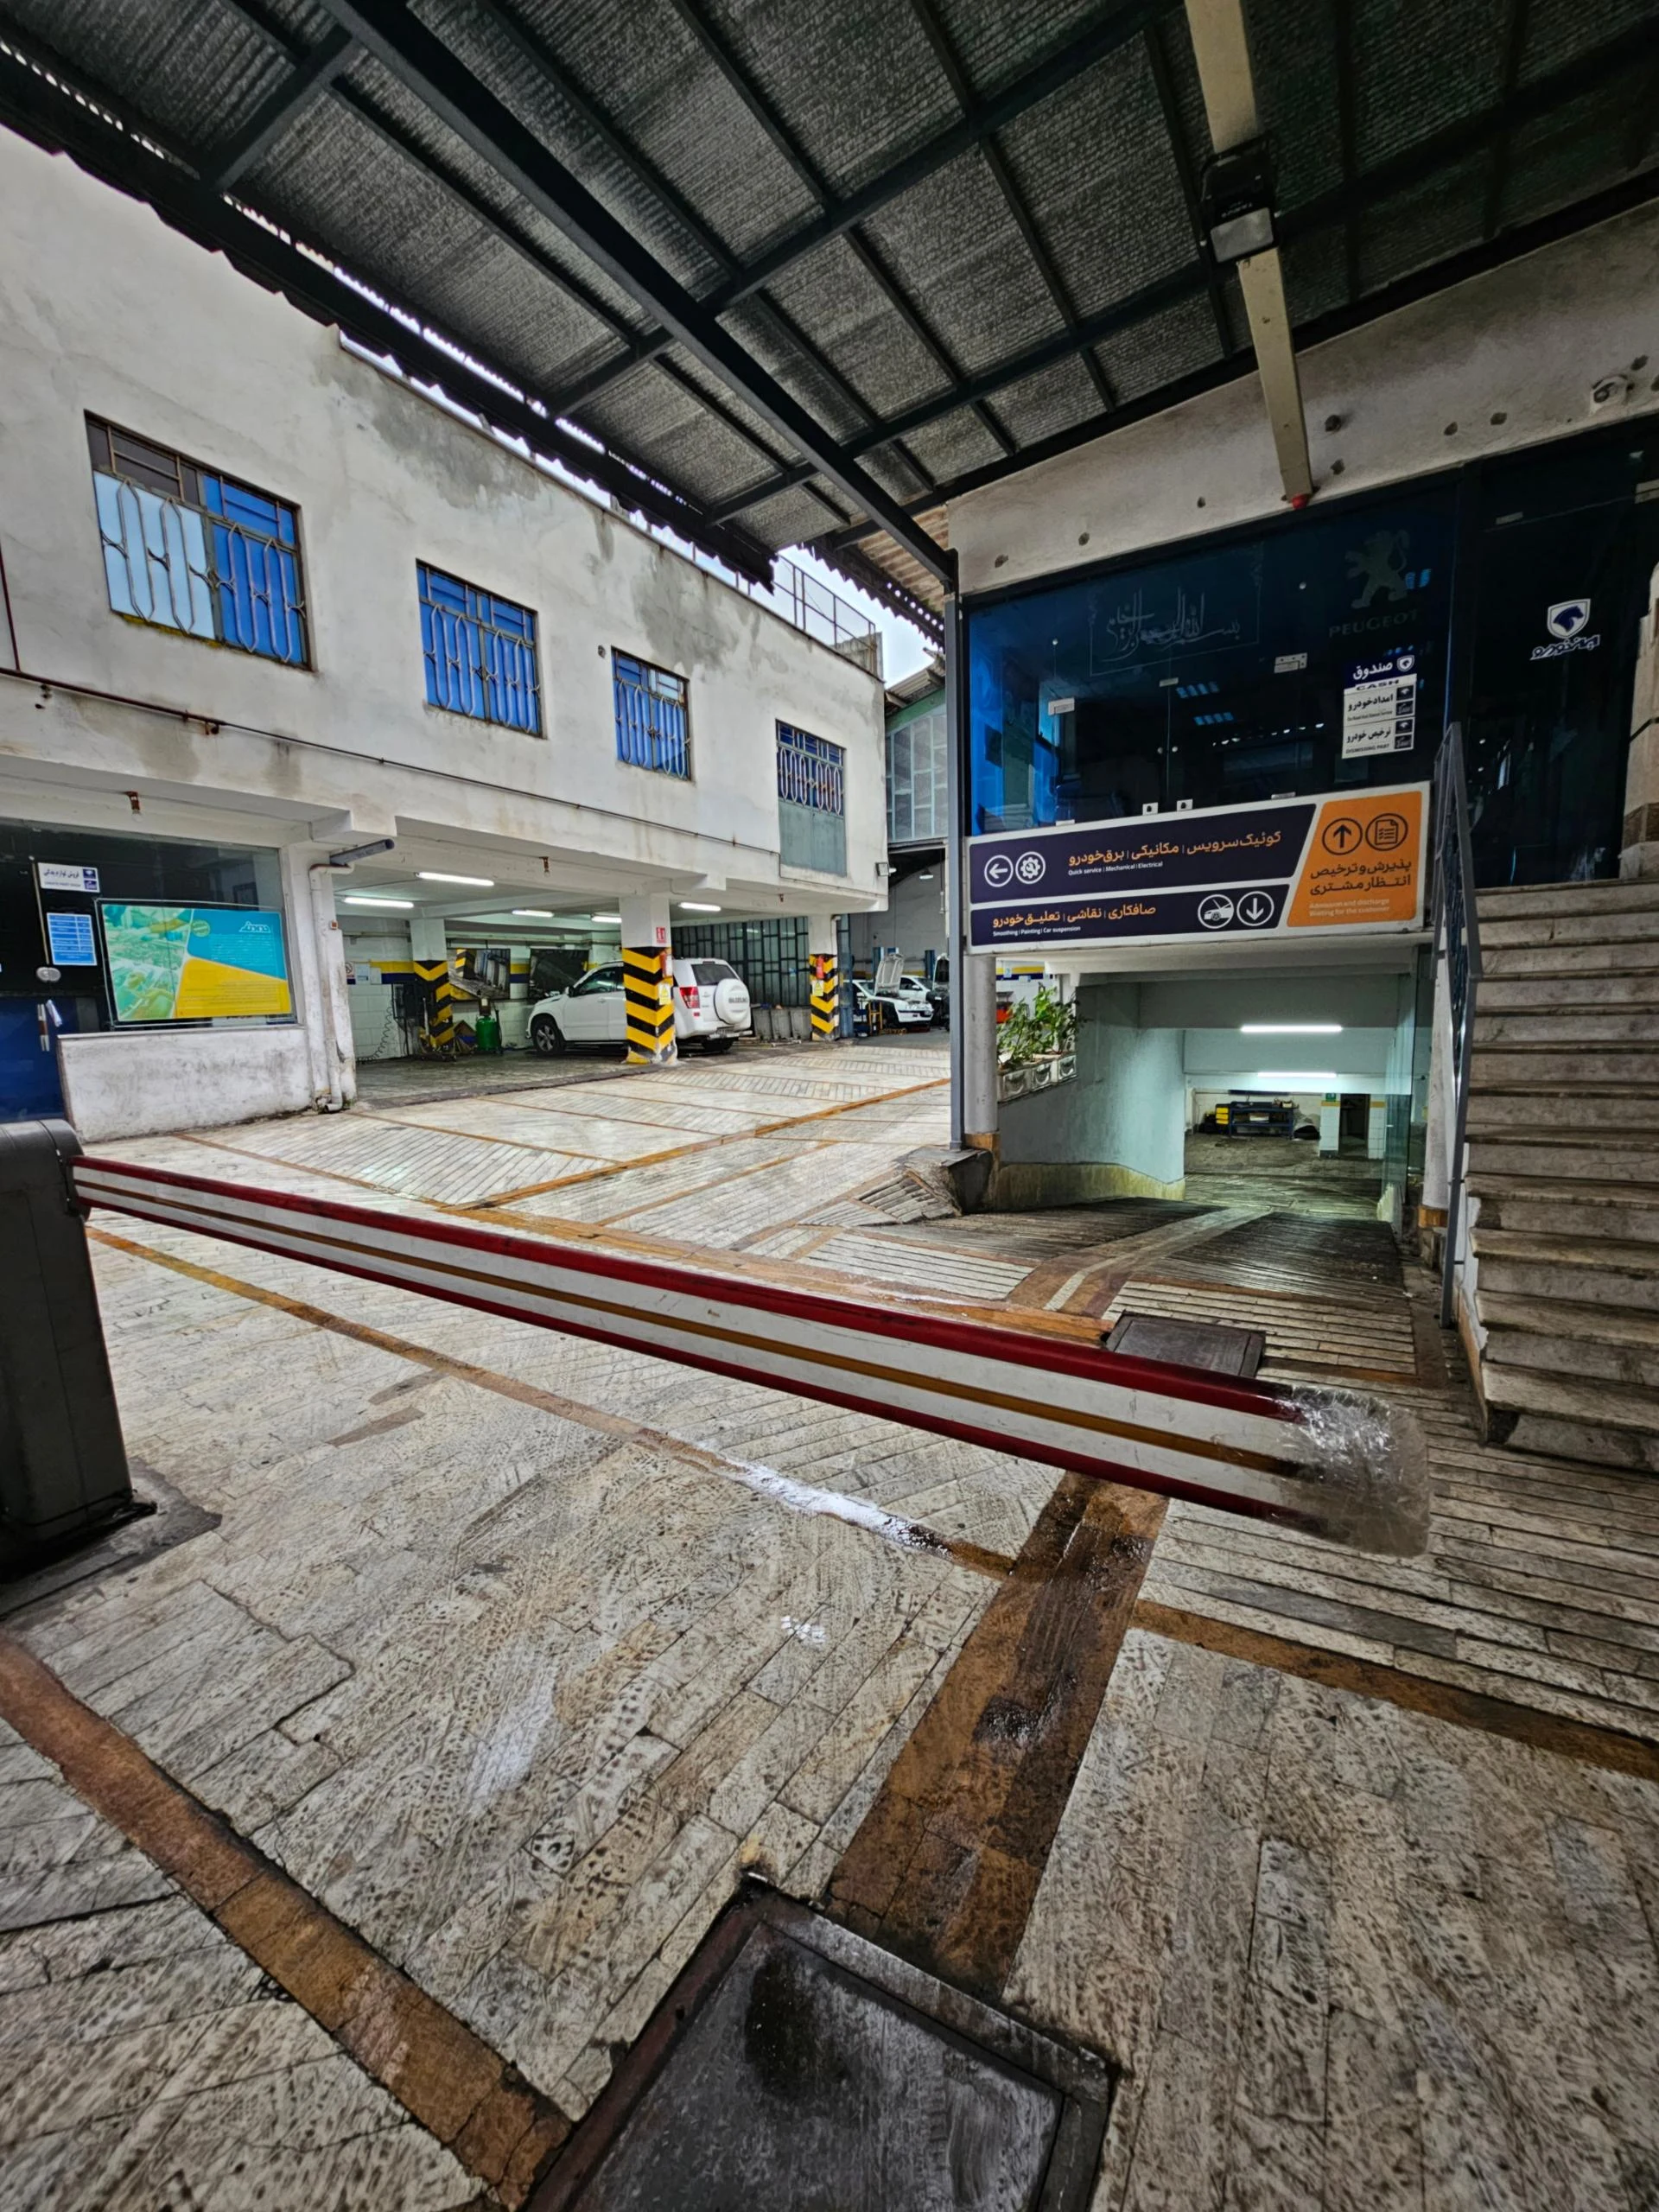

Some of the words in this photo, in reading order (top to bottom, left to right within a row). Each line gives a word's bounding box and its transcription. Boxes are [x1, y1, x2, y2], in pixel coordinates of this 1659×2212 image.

[1328, 608, 1418, 639] PEUGEOT
[1352, 661, 1393, 680] صندوق
[1356, 679, 1399, 690] CASH
[1348, 697, 1373, 712] خودرو
[1373, 694, 1393, 705] امداد
[1347, 730, 1367, 743] خودرو
[1368, 727, 1391, 740] ترخیص
[1131, 842, 1179, 861] مکانیکی
[1186, 839, 1240, 855] سرویس
[1068, 849, 1104, 867] خودرو
[1103, 849, 1124, 862] برق
[1068, 868, 1083, 876] Quick
[1105, 863, 1135, 873] Mechanical
[1138, 861, 1163, 869] Electrical
[1310, 863, 1359, 880] ترخیص
[1367, 859, 1412, 874] پذیرش
[1310, 880, 1363, 896] مشتری
[1024, 911, 1060, 925] تعلیق
[1067, 907, 1103, 924] نقاشی
[1108, 903, 1156, 920] صافکاری
[993, 913, 1025, 928] خودرو
[1020, 927, 1041, 937] Painting
[1052, 925, 1081, 934] suspension
